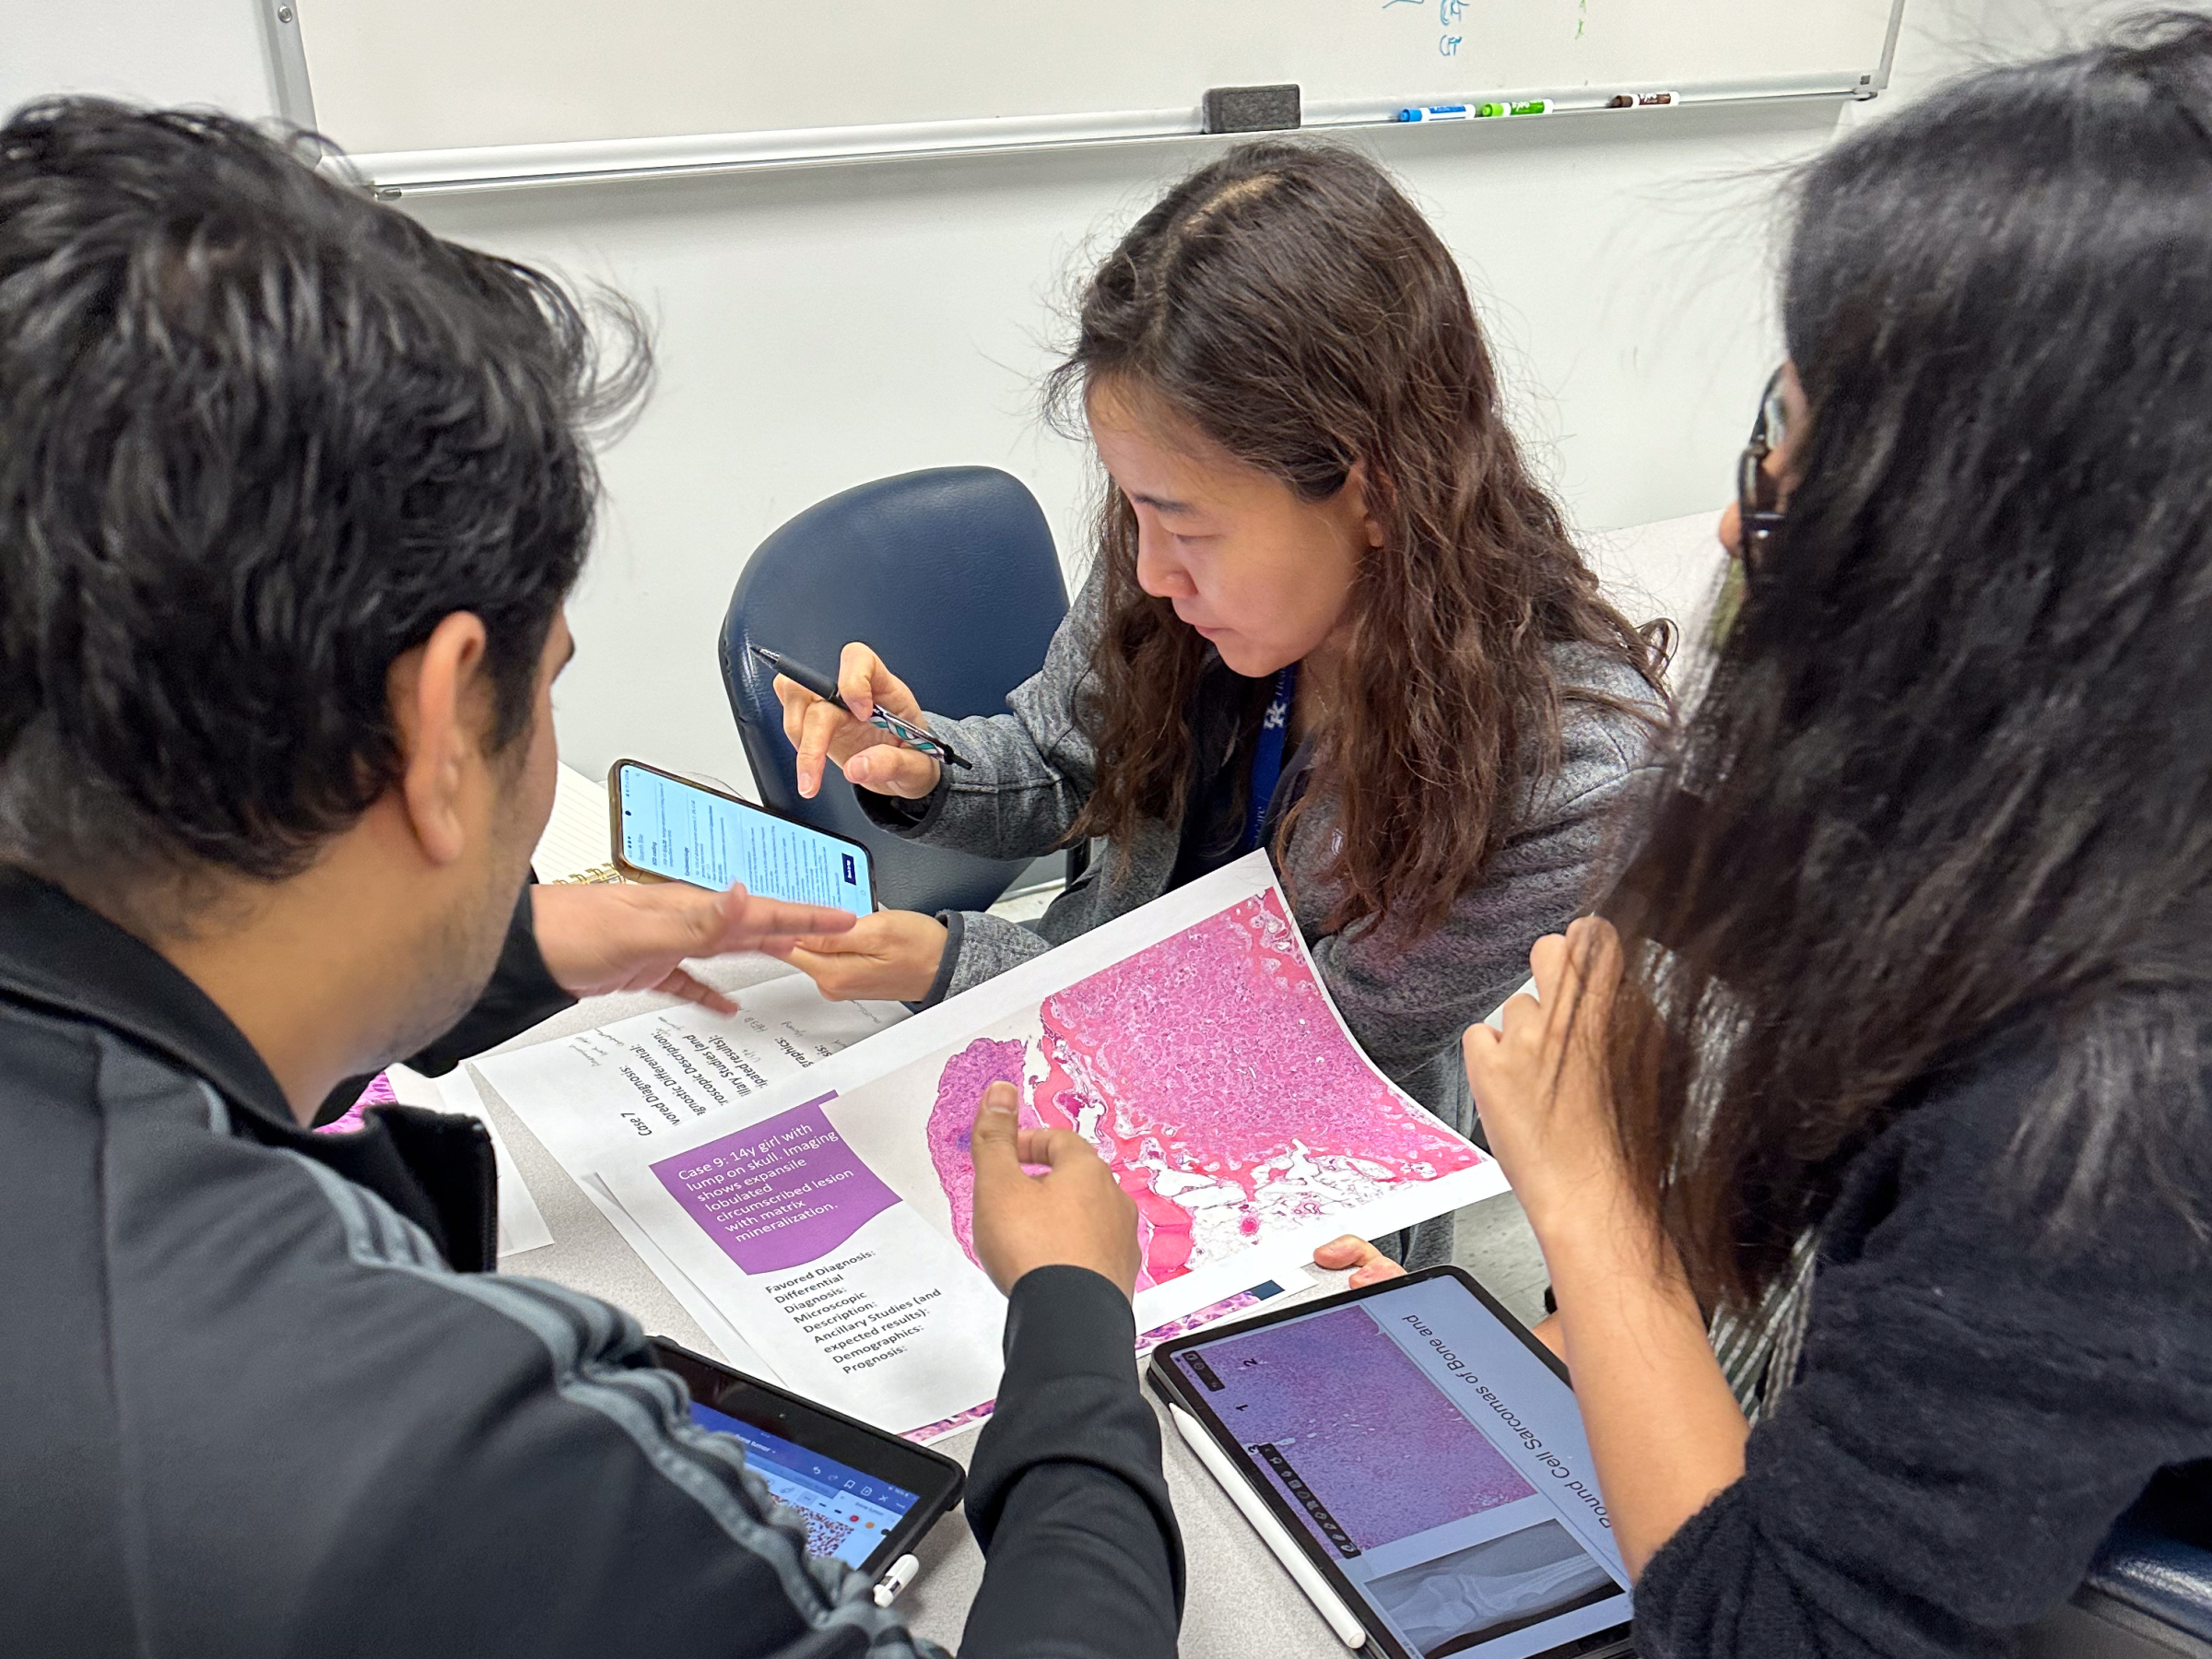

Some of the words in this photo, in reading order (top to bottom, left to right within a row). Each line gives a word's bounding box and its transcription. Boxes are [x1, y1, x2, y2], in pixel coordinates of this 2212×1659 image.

[652, 1030, 697, 1074] Description:
[682, 1035, 709, 1052] (and
[709, 1035, 743, 1063] results):
[629, 1044, 677, 1087] Differential:
[702, 1052, 734, 1077] Studies
[736, 1064, 768, 1088] ipated
[619, 1065, 659, 1102] Diagnosis:
[692, 1074, 728, 1106] roscopic
[633, 1118, 653, 1137] Case
[651, 1102, 680, 1125] vored
[678, 1164, 712, 1180] Case
[713, 1158, 728, 1167] 9:
[730, 1147, 755, 1161] 14y
[759, 1135, 781, 1153] girl
[782, 1124, 812, 1141] with
[687, 1175, 724, 1191] lump
[727, 1167, 746, 1177] on
[747, 1152, 782, 1170] skull.
[782, 1132, 839, 1157] Imaging
[698, 1182, 742, 1201] shows
[744, 1159, 806, 1185] expansile
[705, 1183, 772, 1212] lobulated
[717, 1183, 812, 1221] circumscribed
[811, 1171, 853, 1188] lesion
[725, 1217, 759, 1231] with
[759, 1201, 806, 1219] matrix
[735, 1204, 838, 1241] mineralization.
[765, 1272, 815, 1293] Favored
[815, 1252, 875, 1276] Diagnosis:
[774, 1274, 843, 1303] Differential
[783, 1288, 847, 1313] Diagnosis:
[794, 1293, 866, 1324] Microscopic
[803, 1302, 877, 1333] Description:
[815, 1320, 866, 1343] Ancillary
[868, 1301, 912, 1322] Studies
[912, 1288, 941, 1304] (and
[824, 1327, 879, 1353] expected
[881, 1309, 929, 1331] results):
[1401, 1314, 1433, 1337] and
[832, 1325, 924, 1363] Demographics:
[1430, 1337, 1465, 1371] Bone
[842, 1347, 907, 1373] Prognosis:
[1455, 1371, 1478, 1384] of
[1476, 1385, 1543, 1451] Sarcomas
[1535, 1451, 1571, 1479] Cell
